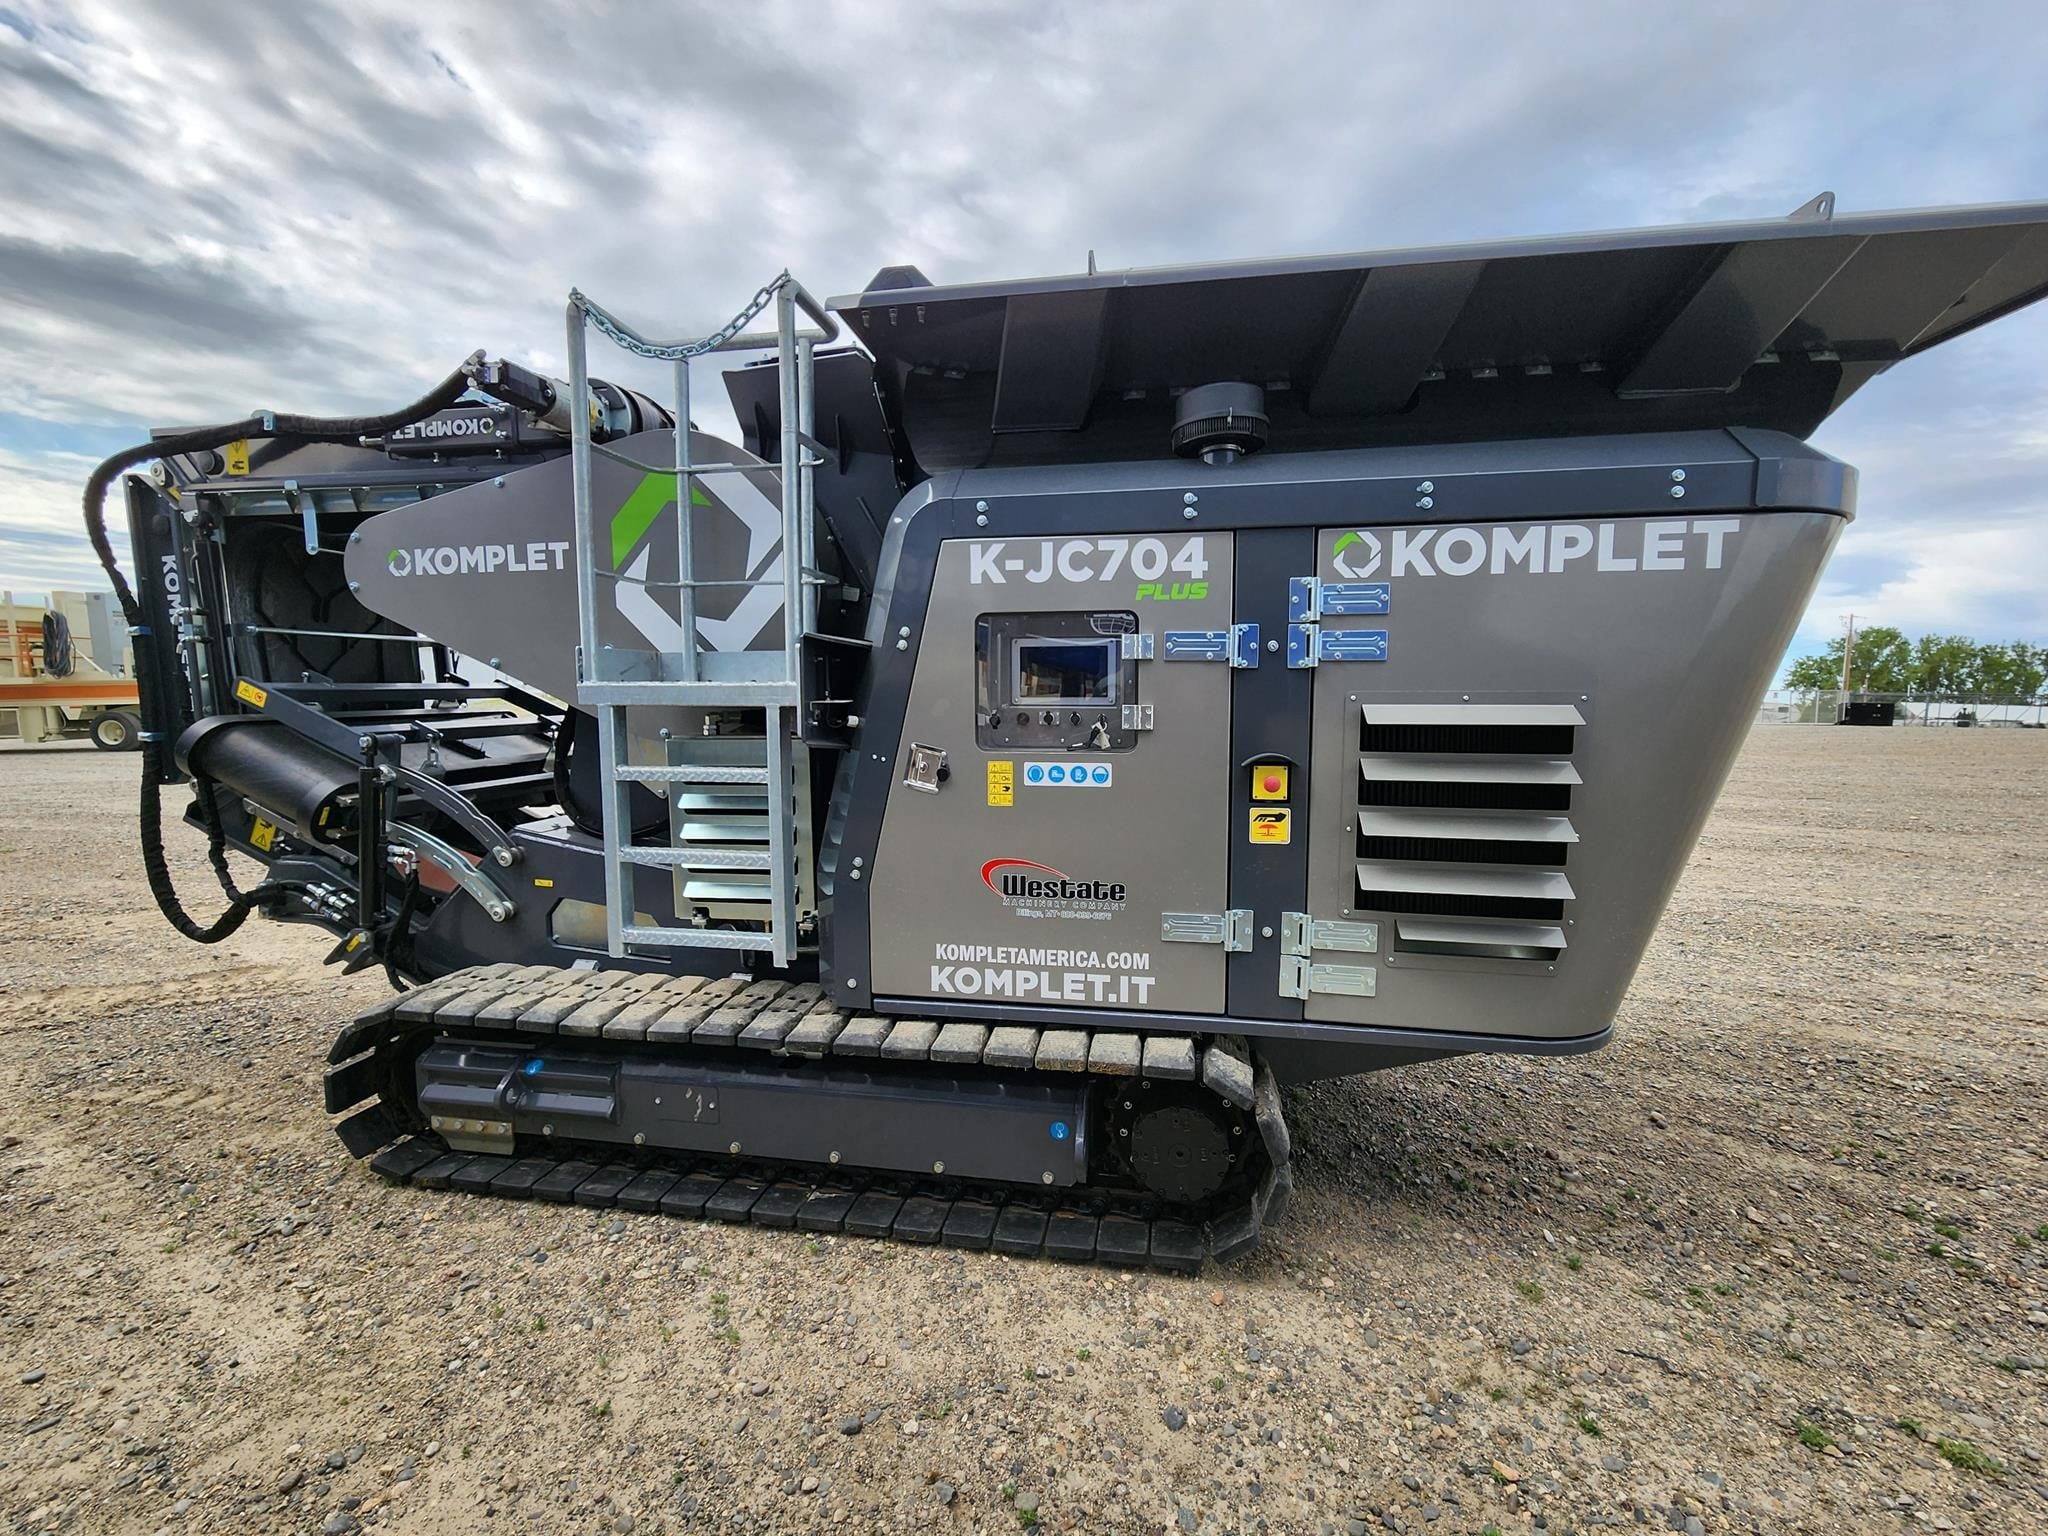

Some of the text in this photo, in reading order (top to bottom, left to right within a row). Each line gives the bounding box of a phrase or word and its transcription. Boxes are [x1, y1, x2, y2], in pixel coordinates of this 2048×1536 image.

[392, 418, 479, 440] KOMPLET
[414, 541, 570, 576] KOMPLET
[969, 536, 1209, 584] K-JC704
[1390, 519, 1741, 577] KOMPLET
[1135, 581, 1209, 601] PLUS
[1002, 873, 1127, 901] Westate
[1002, 899, 1127, 911] MACHINERY COMPANY
[935, 943, 1150, 970] KOMPLETAMERICA.COM
[930, 965, 1156, 1005] KOMPLET.IT
